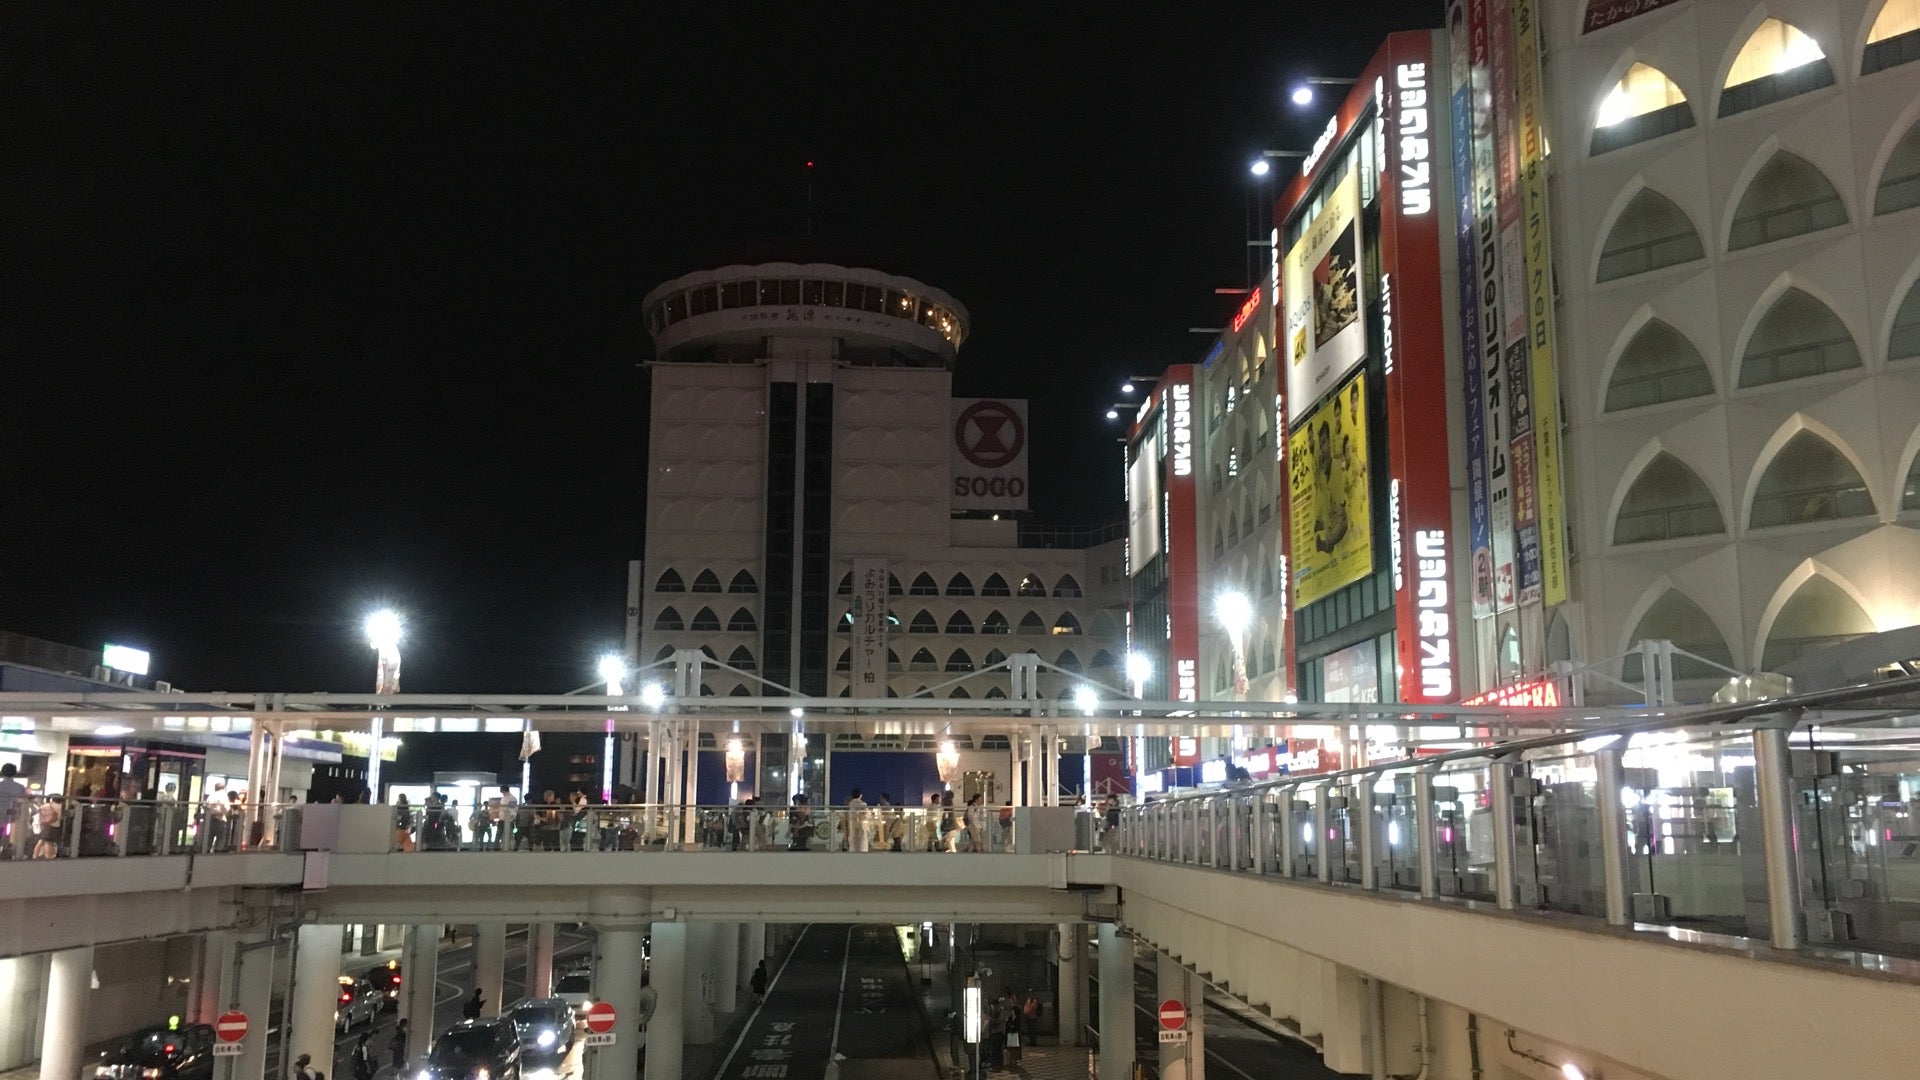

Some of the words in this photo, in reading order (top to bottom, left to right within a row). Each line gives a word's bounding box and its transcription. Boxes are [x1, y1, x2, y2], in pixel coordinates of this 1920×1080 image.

[1589, 0, 1663, 27] たかの
[1397, 62, 1430, 216] ビックカメラ
[1294, 338, 1306, 361] 4K
[1382, 273, 1393, 375] HITACHI
[954, 476, 1025, 498] SOGO
[1390, 479, 1404, 591] OLYMPUS
[864, 568, 875, 684] よみうりカルチャー柏
[1415, 530, 1453, 697] ビックカメラ
